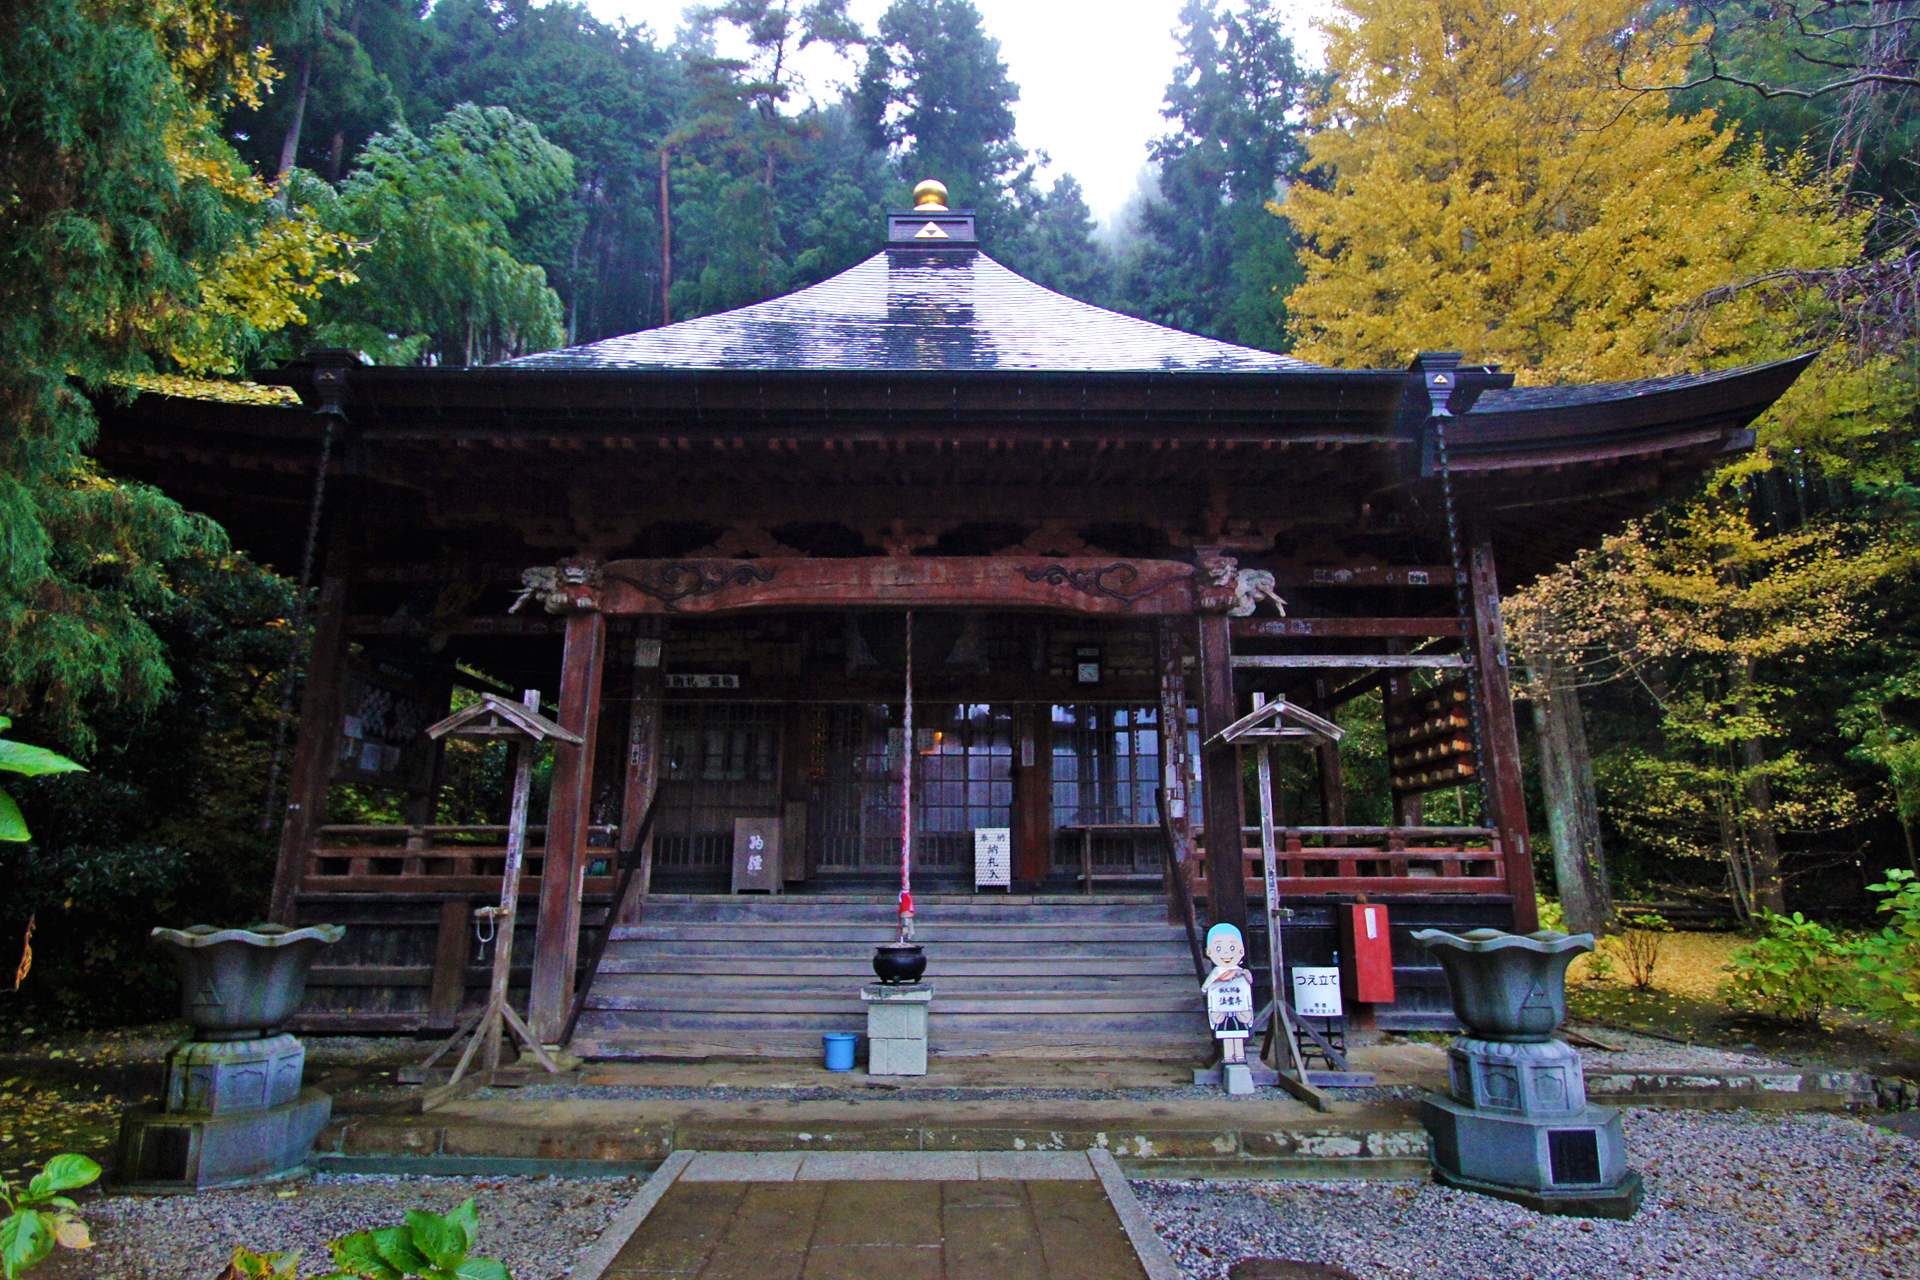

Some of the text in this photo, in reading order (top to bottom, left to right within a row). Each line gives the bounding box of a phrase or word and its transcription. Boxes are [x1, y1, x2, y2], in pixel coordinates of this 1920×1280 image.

[987, 844, 999, 879] 納札入
[1295, 974, 1337, 986] つえ立て
